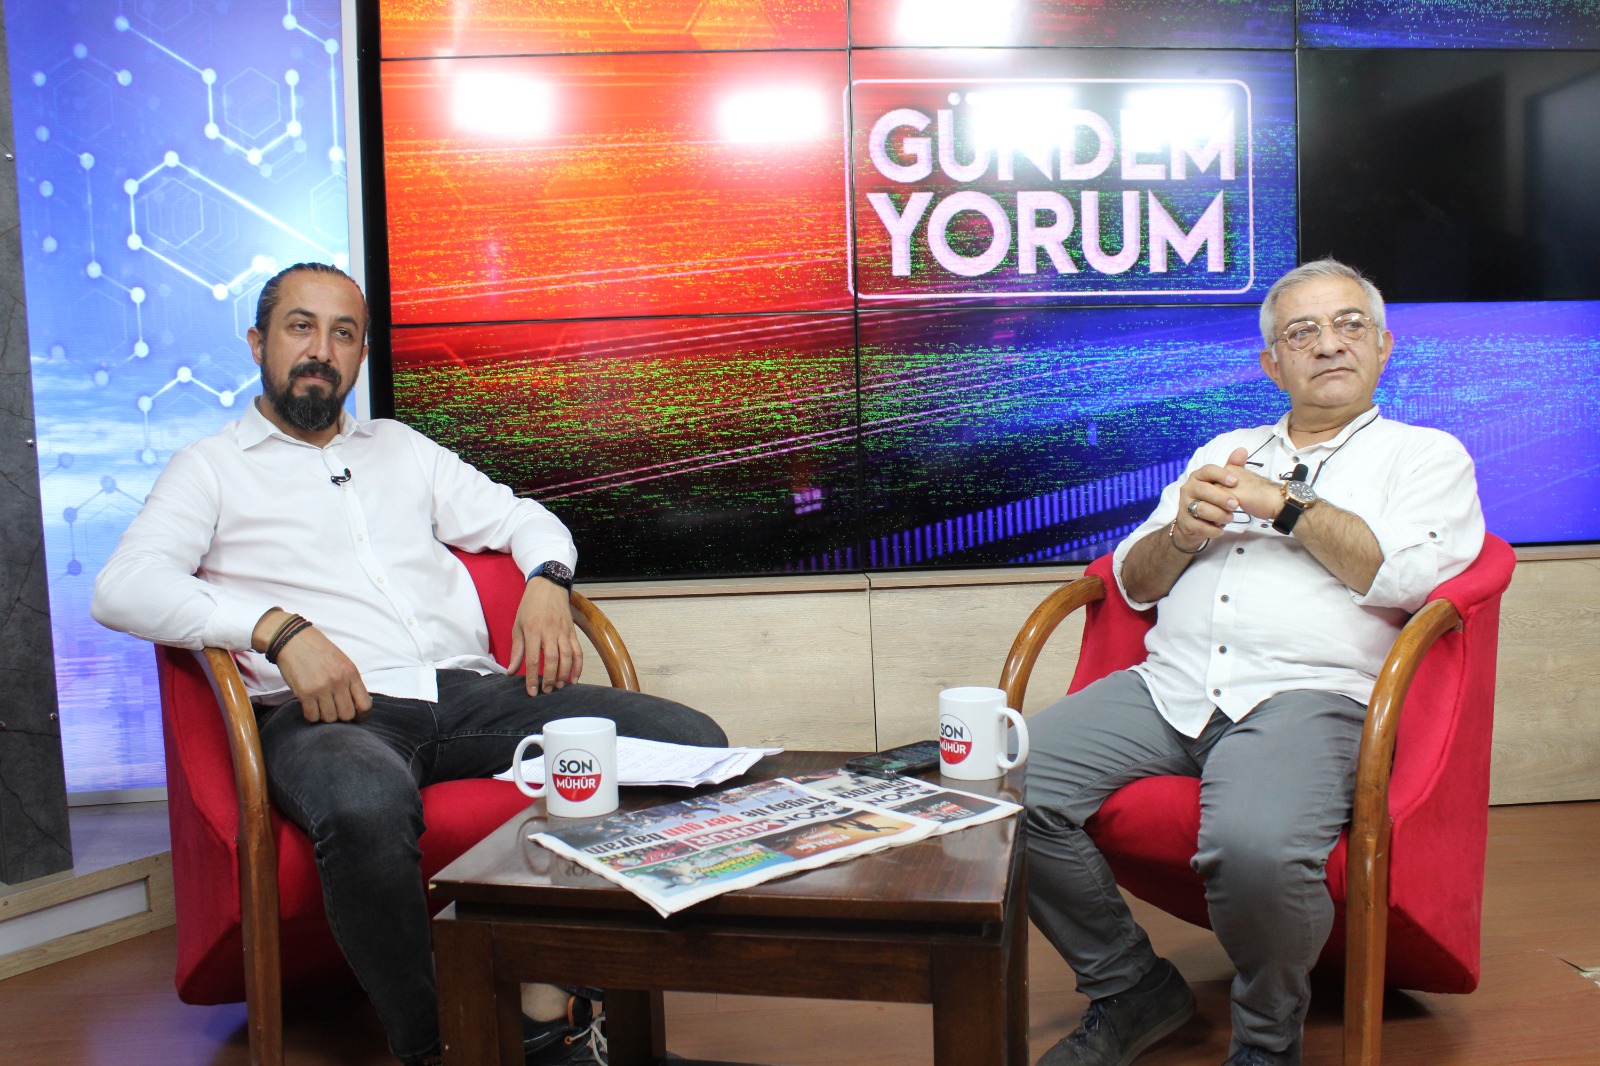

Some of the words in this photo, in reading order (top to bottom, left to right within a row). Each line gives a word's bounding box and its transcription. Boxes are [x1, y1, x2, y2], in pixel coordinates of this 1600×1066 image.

[868, 92, 1235, 182] GÜNDEM
[866, 189, 1225, 276] YORUM
[941, 723, 964, 740] SON
[559, 759, 593, 774] SON
[556, 776, 596, 790] MÜHÜR
[765, 796, 828, 812] Tugay
[704, 814, 743, 827] her
[661, 821, 705, 837] gün
[584, 832, 669, 854] bayram
